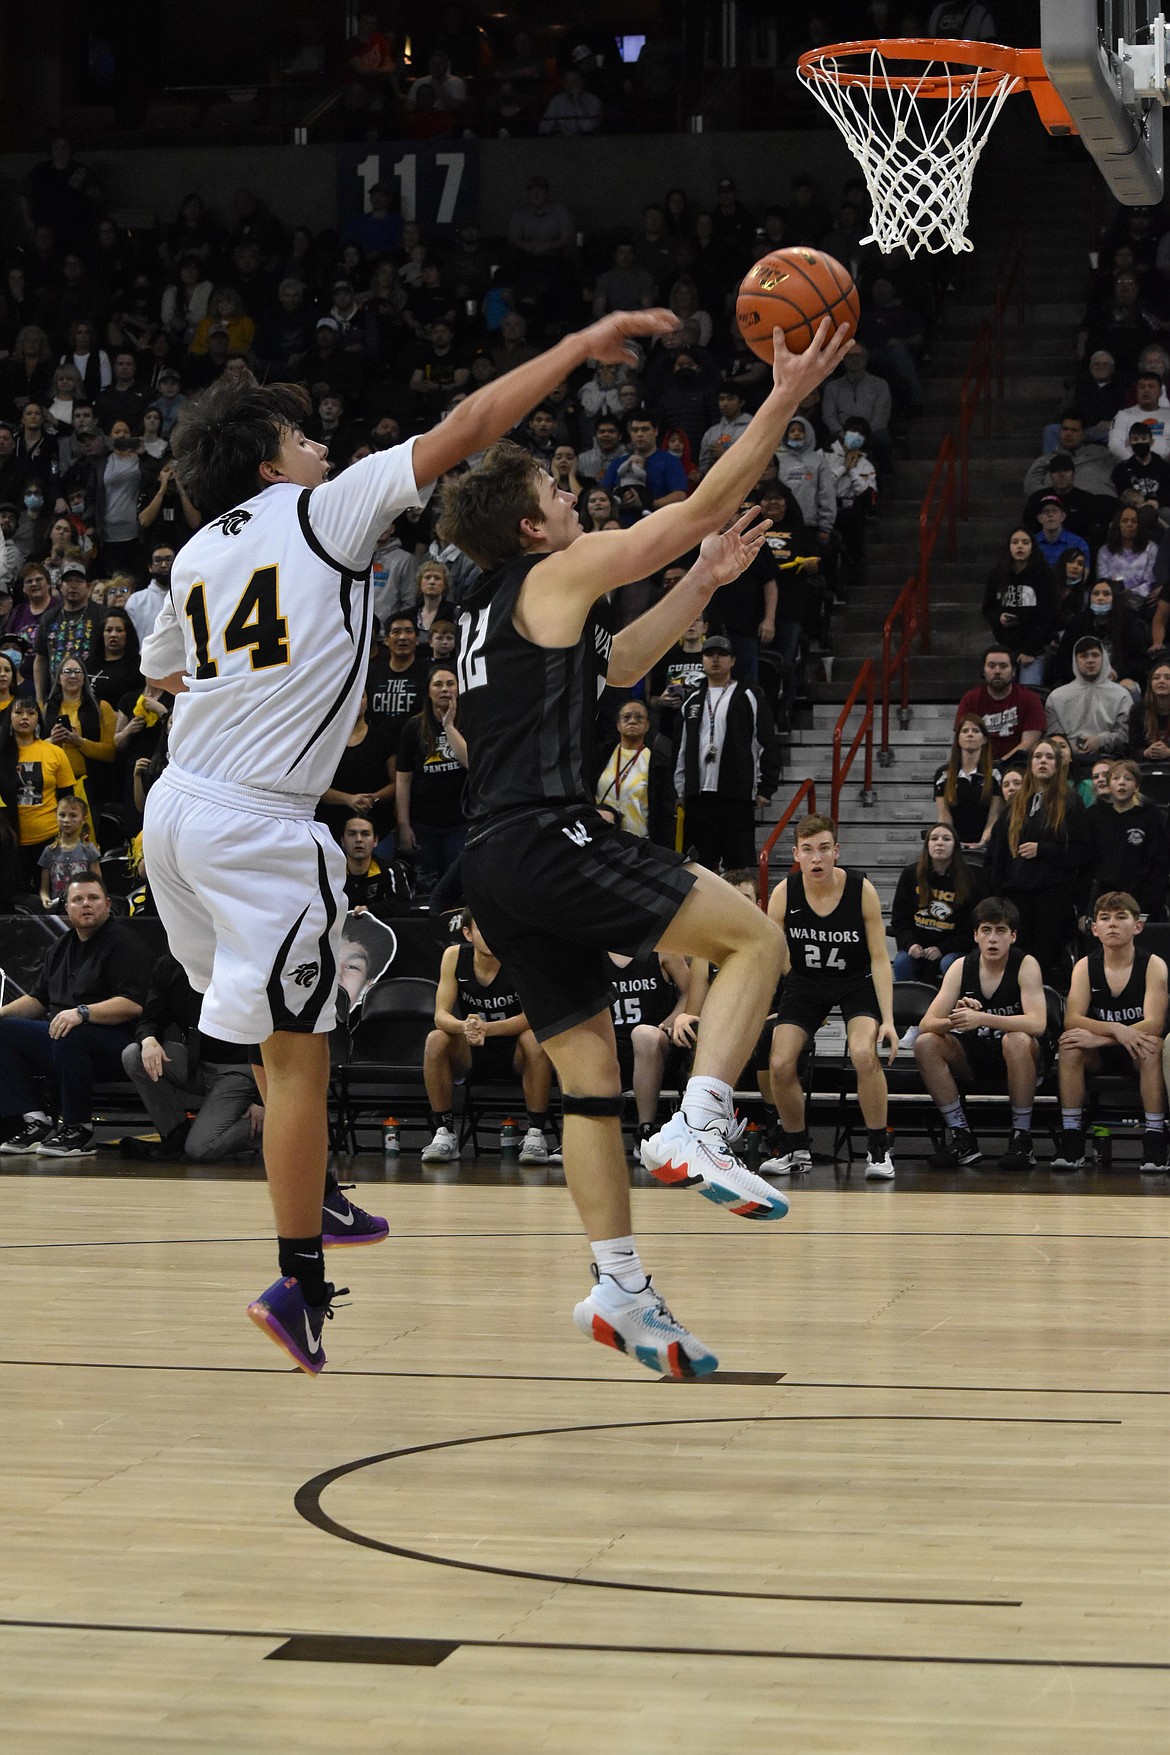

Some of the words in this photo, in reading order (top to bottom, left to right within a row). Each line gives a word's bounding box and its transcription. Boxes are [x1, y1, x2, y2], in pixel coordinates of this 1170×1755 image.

[357, 153, 465, 223] 117
[184, 563, 291, 680] 14
[457, 603, 492, 695] 12
[668, 663, 705, 673] CUSIC
[386, 679, 408, 693] THE
[372, 692, 417, 712] CHIEF
[423, 761, 462, 773] PANTHE
[789, 927, 860, 943] WARRIORS
[804, 944, 847, 970] 24
[613, 997, 642, 1025] 15
[1096, 1006, 1144, 1022] ARRIOR
